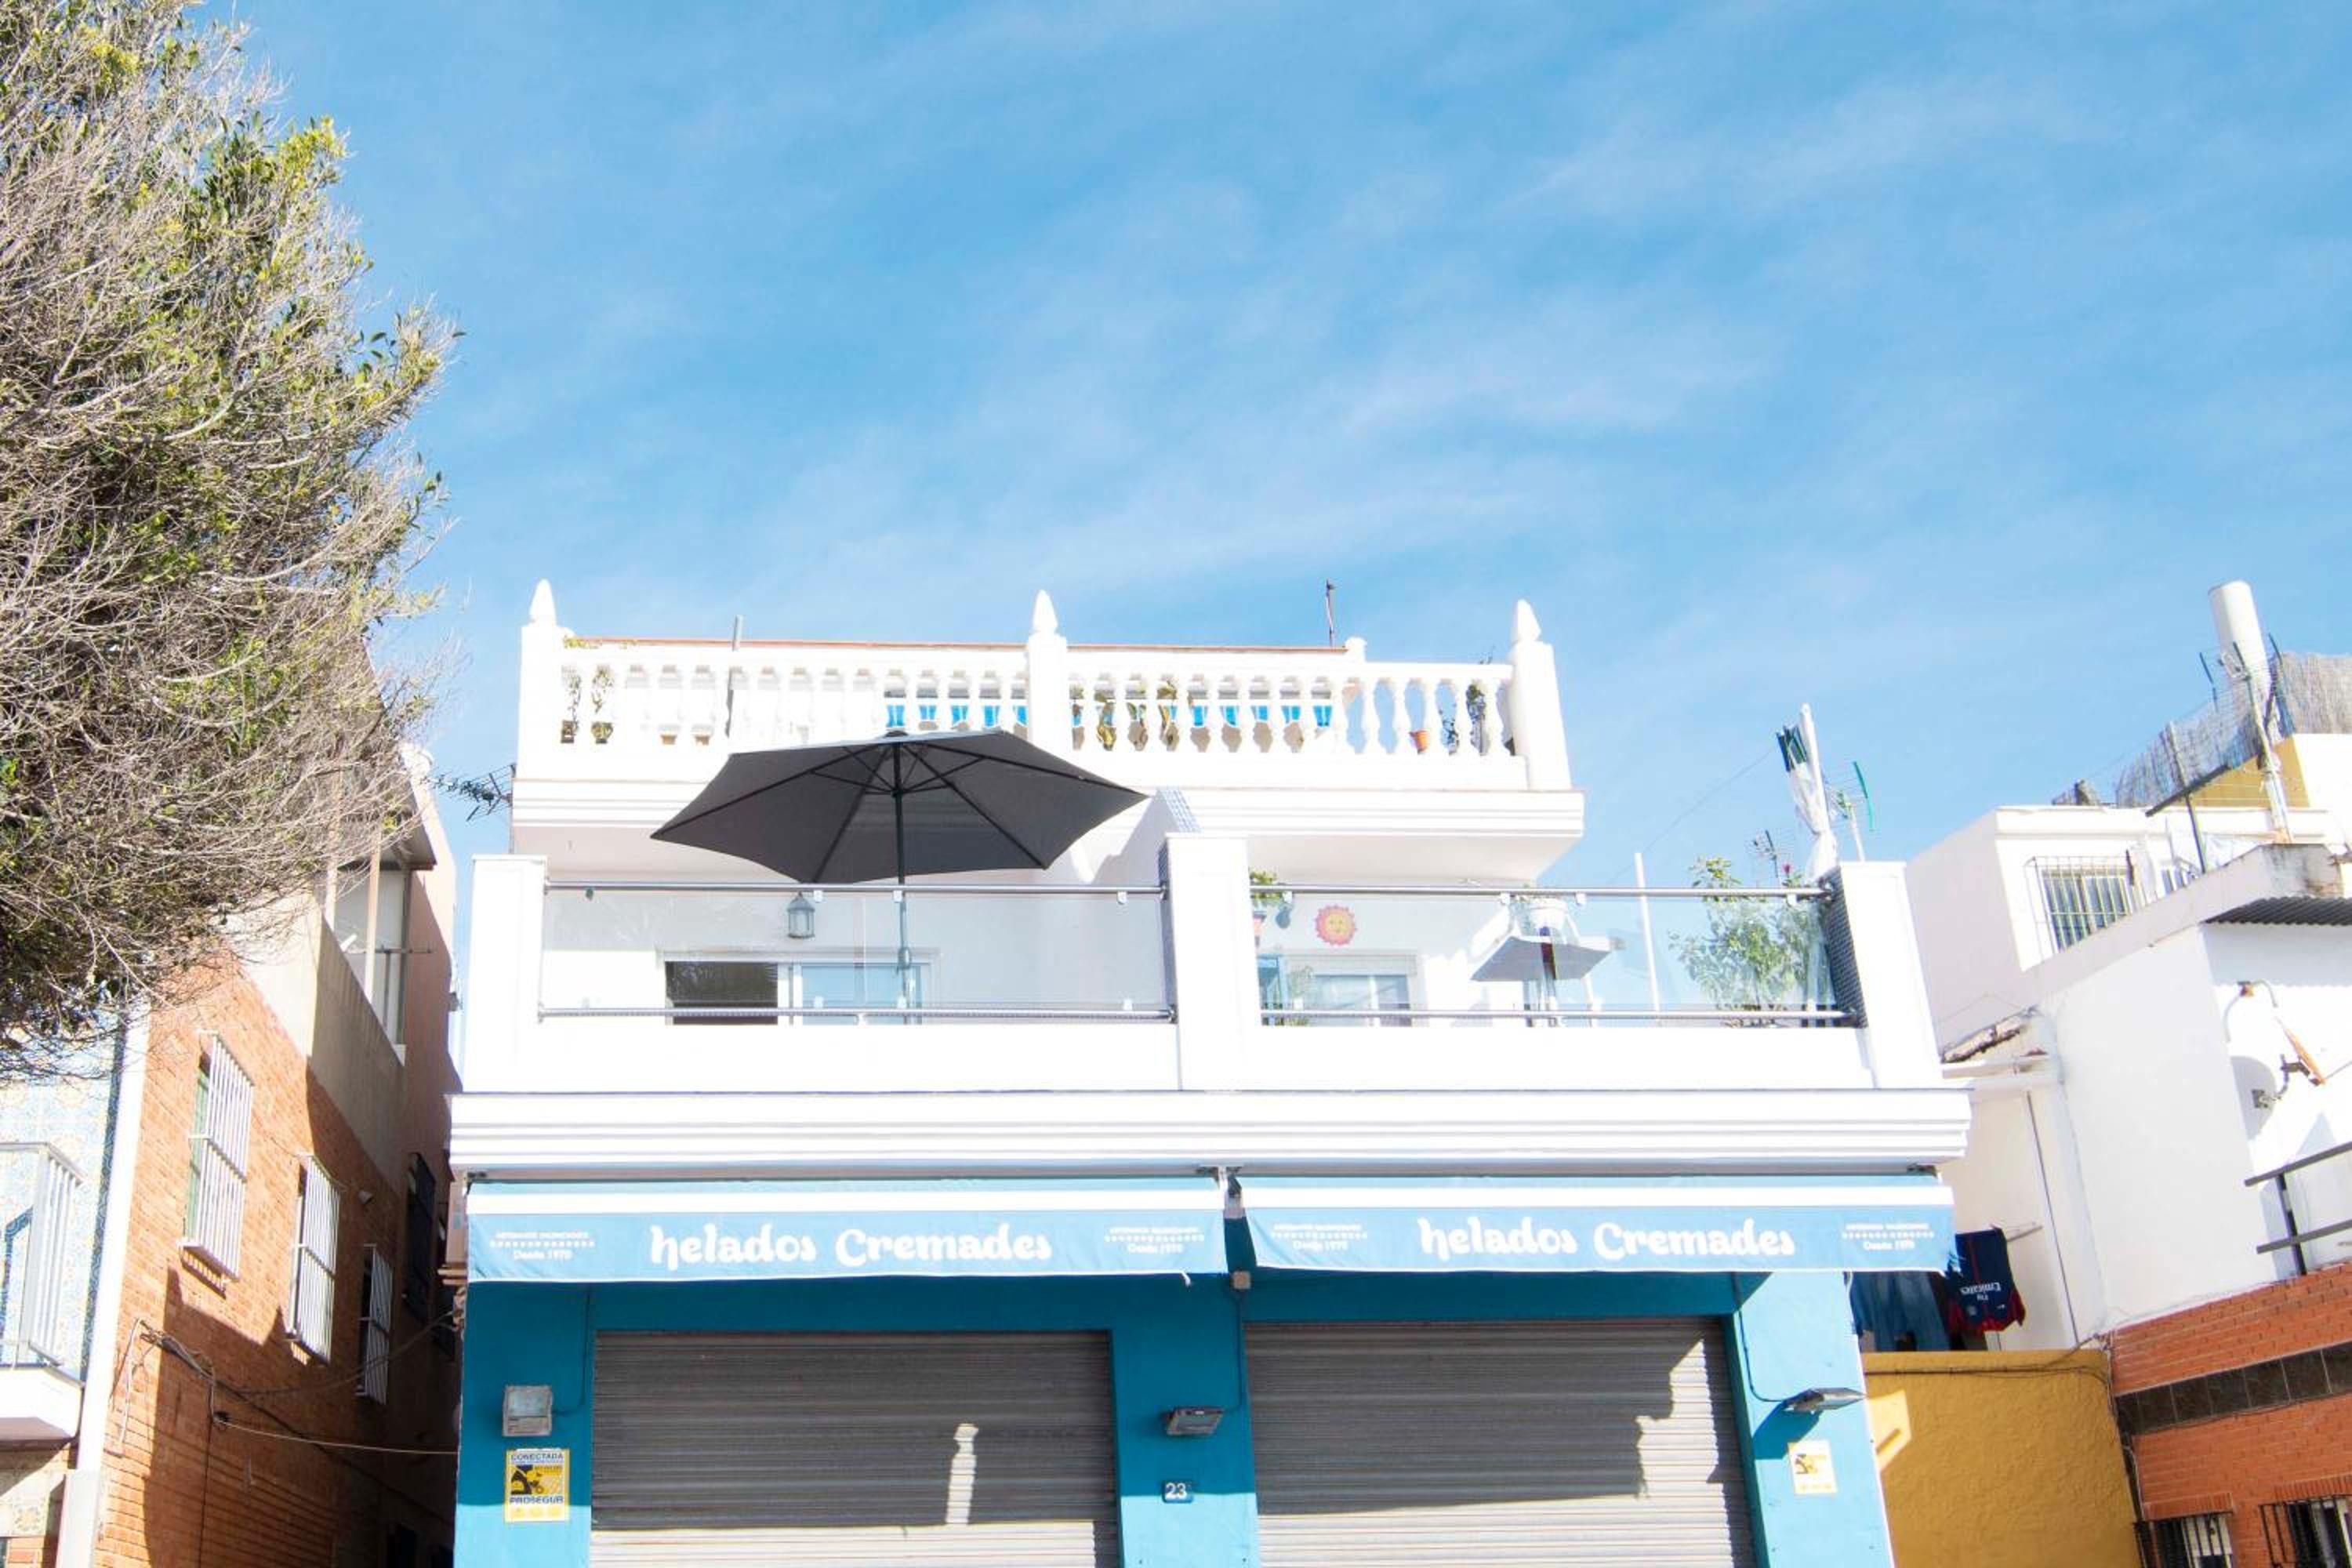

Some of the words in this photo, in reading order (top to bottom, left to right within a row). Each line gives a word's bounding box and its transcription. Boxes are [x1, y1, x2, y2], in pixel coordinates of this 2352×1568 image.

[651, 1223, 817, 1270] helados
[834, 1222, 1053, 1267] Cremades
[1417, 1216, 1578, 1261] helados
[1593, 1218, 1795, 1260] Cremades
[1166, 1482, 1188, 1500] 23
